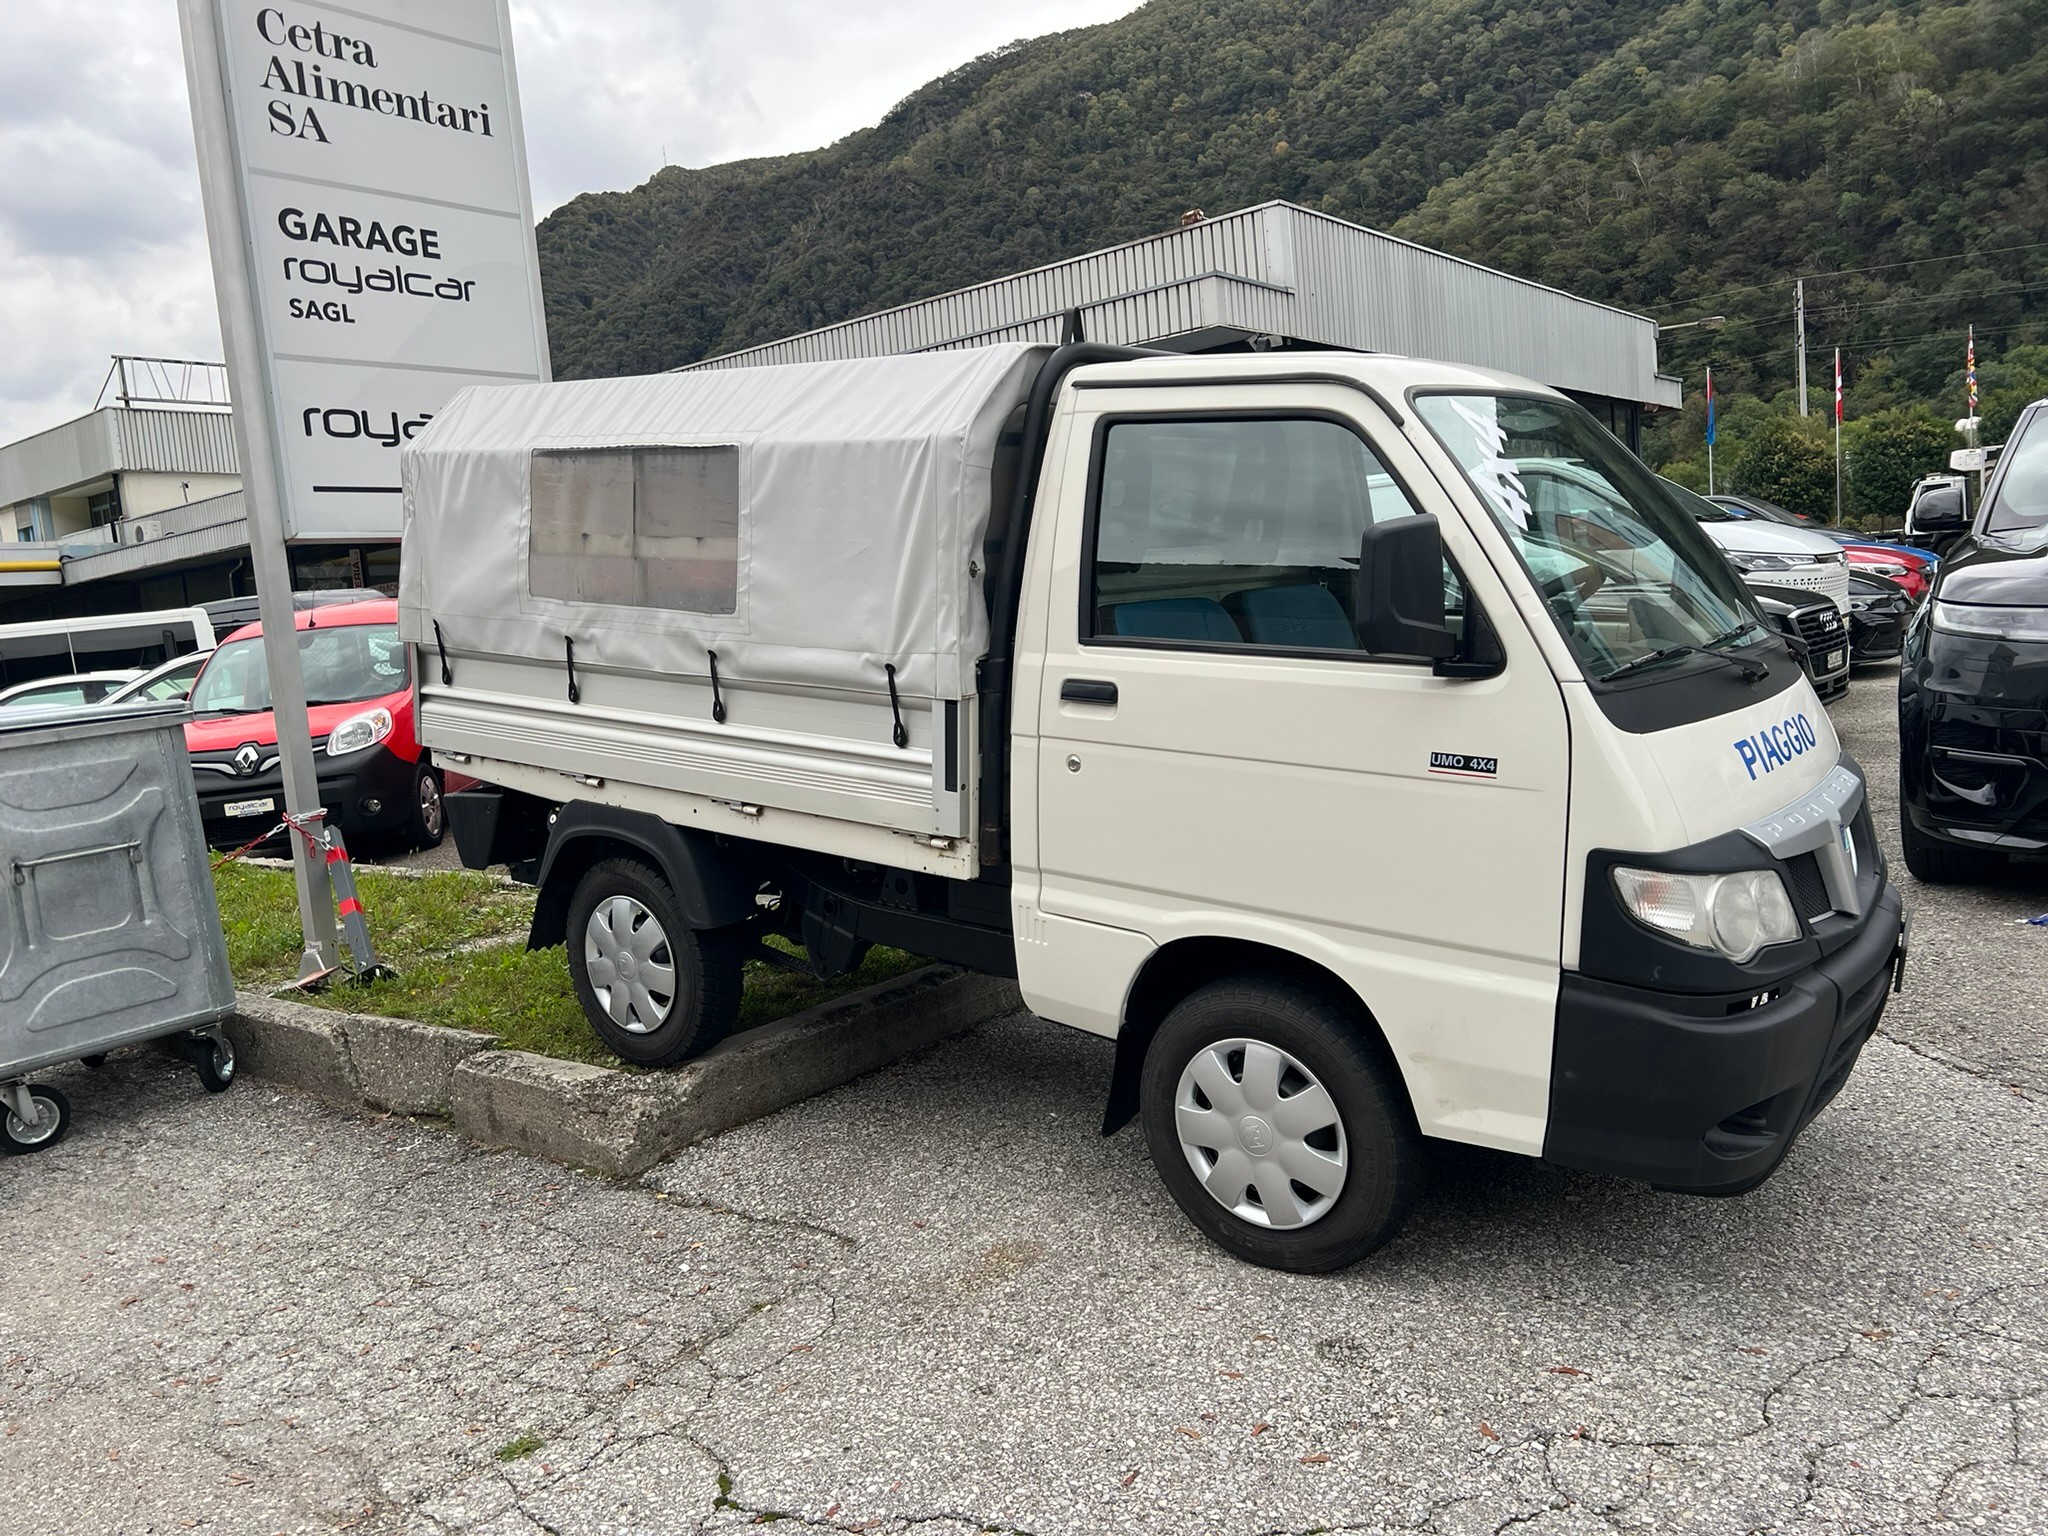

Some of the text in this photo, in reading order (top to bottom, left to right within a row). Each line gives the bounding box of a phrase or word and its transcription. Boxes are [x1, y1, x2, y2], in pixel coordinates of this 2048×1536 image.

[256, 8, 378, 68] Cetra
[259, 55, 494, 137] Alimentari
[268, 100, 332, 144] SA
[278, 207, 441, 260] GARAGE
[283, 257, 476, 302] royalcar
[289, 297, 356, 324] SAGL
[1431, 753, 1496, 771] UMO 4X4
[1733, 713, 1817, 782] PIAGGIO
[1760, 773, 1854, 838] PORTER
